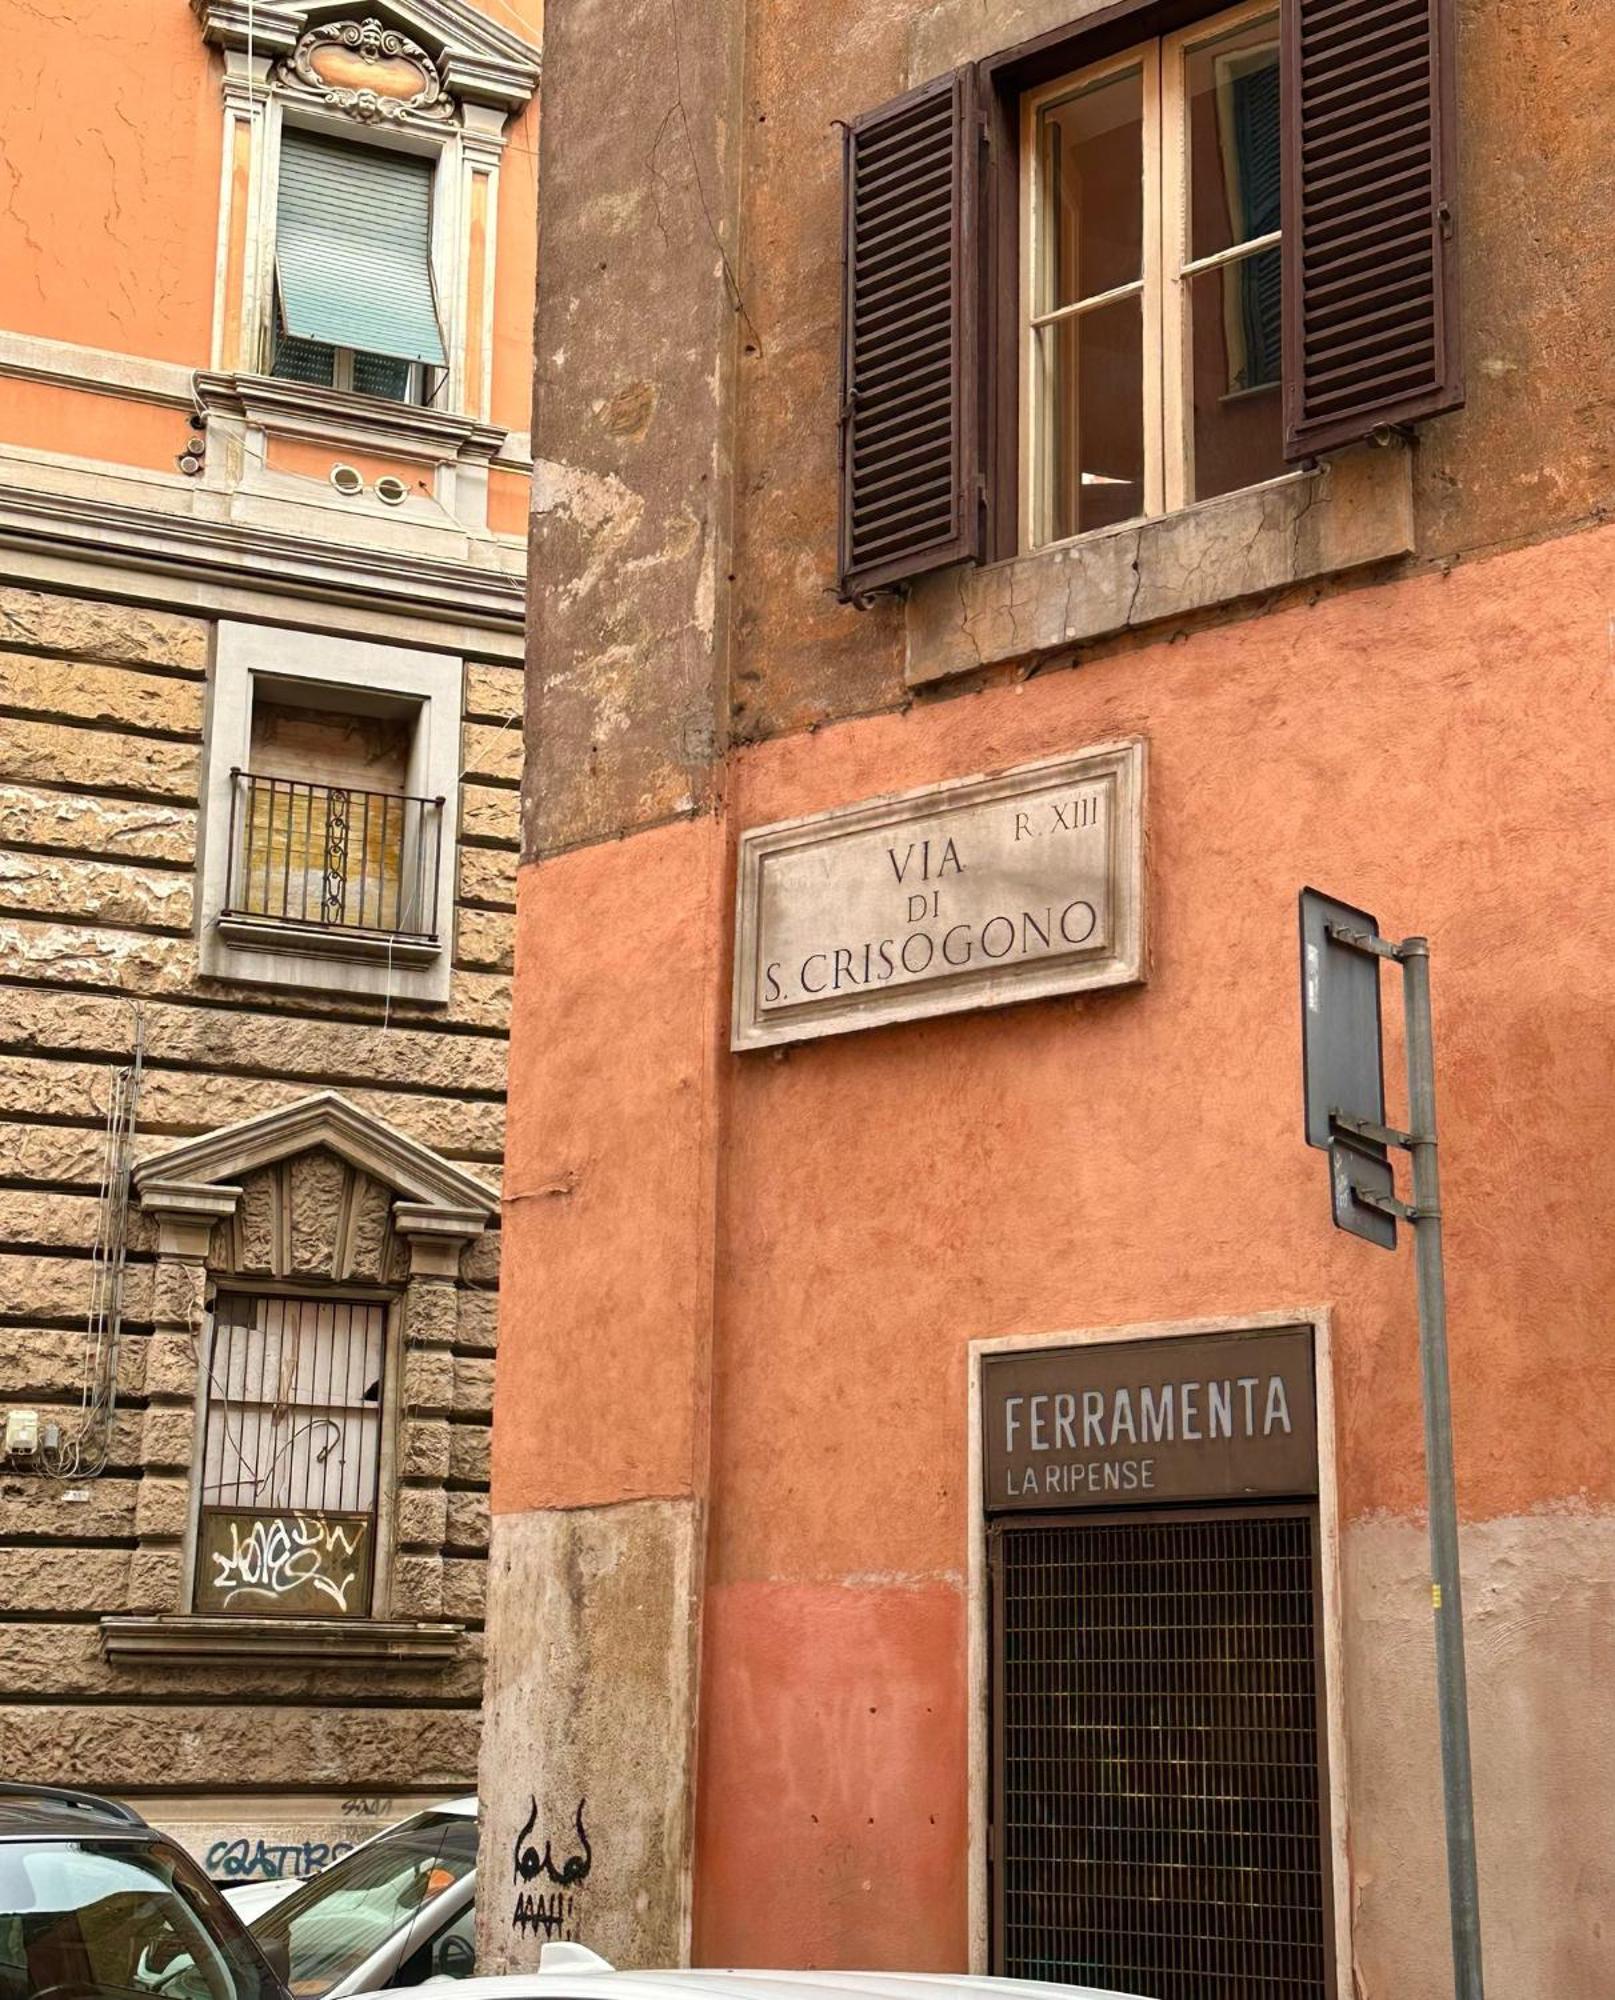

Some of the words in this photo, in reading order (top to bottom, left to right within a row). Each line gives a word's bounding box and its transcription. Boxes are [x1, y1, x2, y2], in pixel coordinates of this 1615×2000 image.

[1014, 812, 1043, 841] R.
[1051, 797, 1098, 834] XIII
[887, 837, 963, 884] VIA
[907, 891, 939, 923] DI
[765, 962, 788, 1002] S.
[800, 900, 1097, 994] CRISOGONO
[1005, 1375, 1291, 1452] FERRAMENTA
[1007, 1467, 1038, 1495] LA
[1045, 1460, 1155, 1493] RIPENSE
